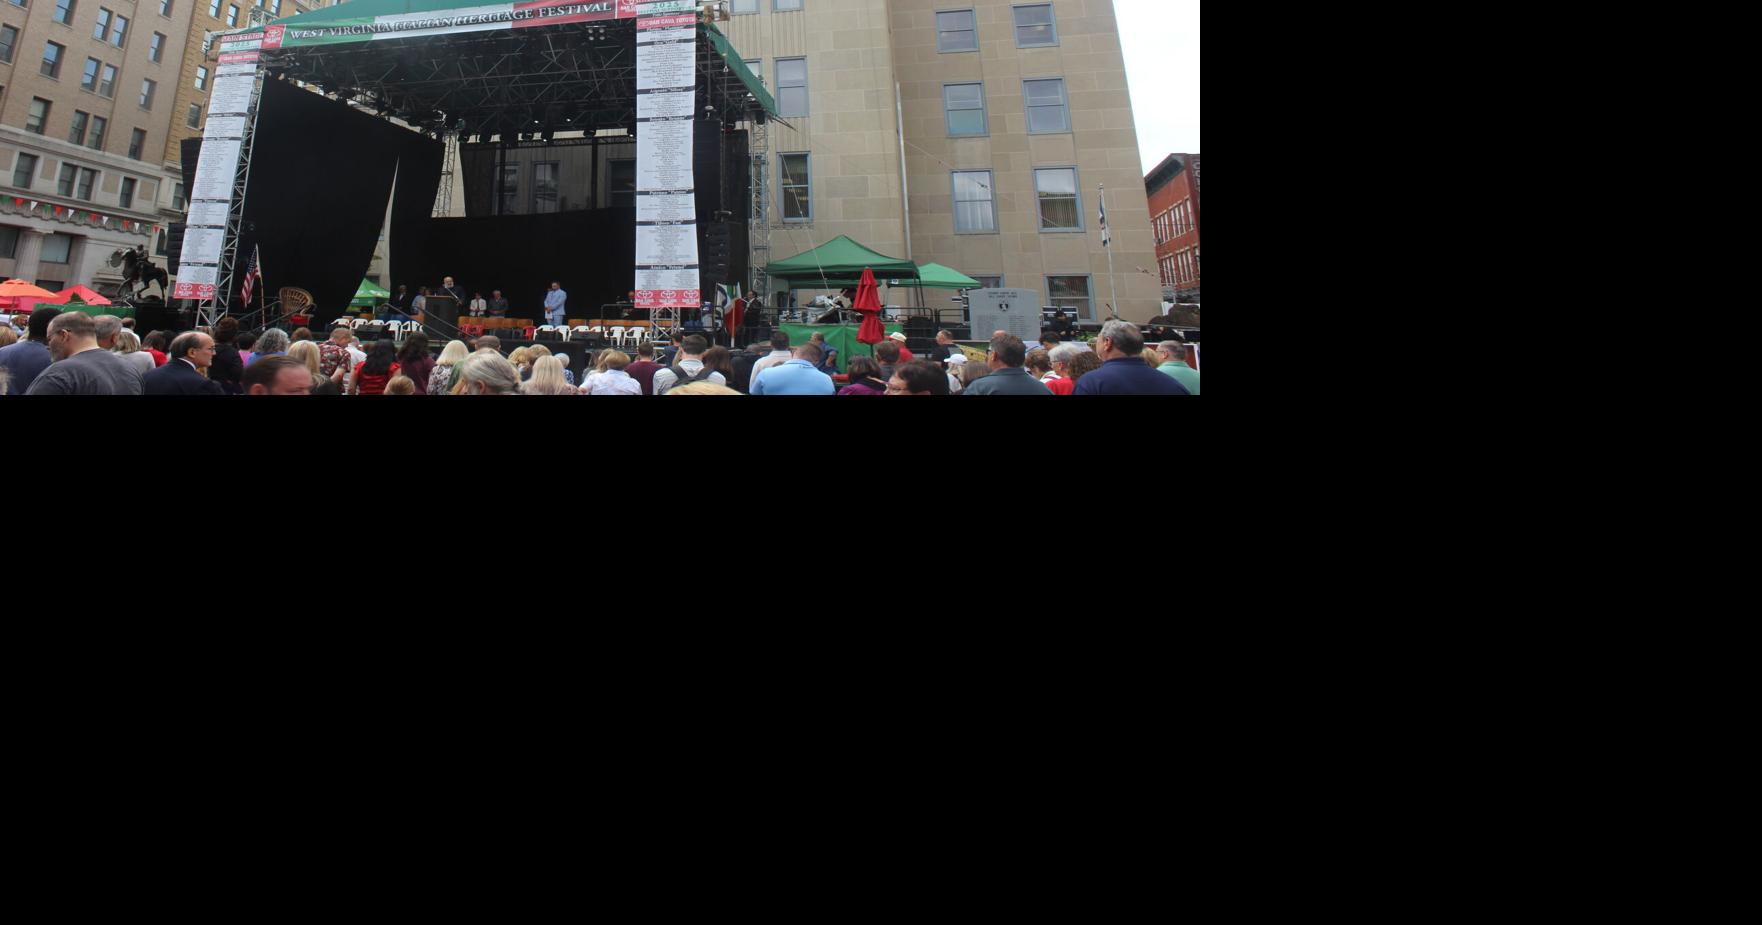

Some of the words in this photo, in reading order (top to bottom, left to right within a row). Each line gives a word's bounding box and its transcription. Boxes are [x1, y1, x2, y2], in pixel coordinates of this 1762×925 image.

[290, 29, 327, 40] WEST
[329, 22, 391, 37] VIRGINIA
[393, 17, 453, 32] ITALIAN
[455, 9, 534, 26] HERITAGE
[539, 2, 612, 18] FESTIVAL
